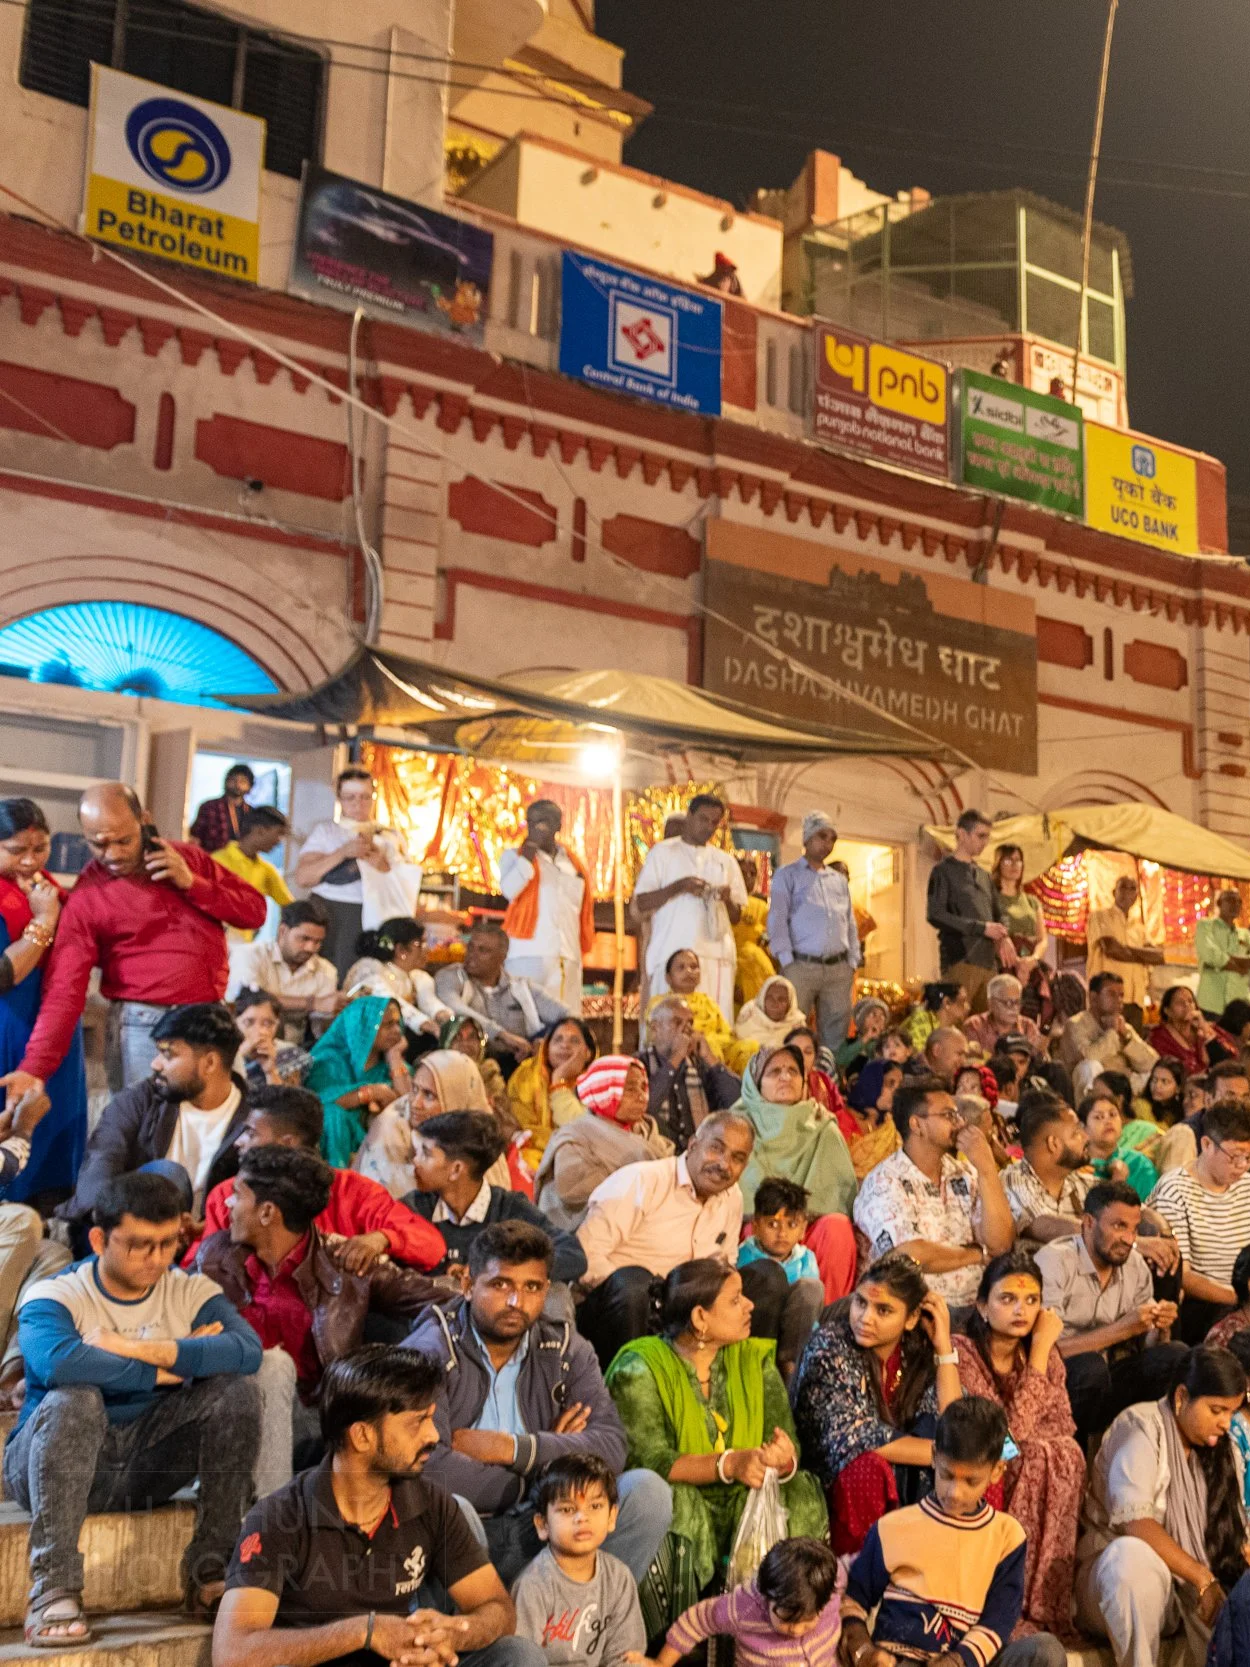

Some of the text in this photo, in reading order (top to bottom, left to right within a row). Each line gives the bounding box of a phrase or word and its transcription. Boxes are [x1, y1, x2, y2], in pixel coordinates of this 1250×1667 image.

[128, 189, 224, 240] Bharat
[98, 208, 248, 274] Petroleum
[582, 364, 700, 410] Central Bank of India
[878, 365, 939, 404] pnb
[816, 412, 862, 436] punjab
[862, 425, 914, 452] national
[914, 440, 945, 462] bank
[986, 405, 1024, 425] sidbi
[1111, 504, 1179, 541] UCO BANK
[939, 646, 1001, 691] घाट
[964, 704, 1024, 738] GHAT
